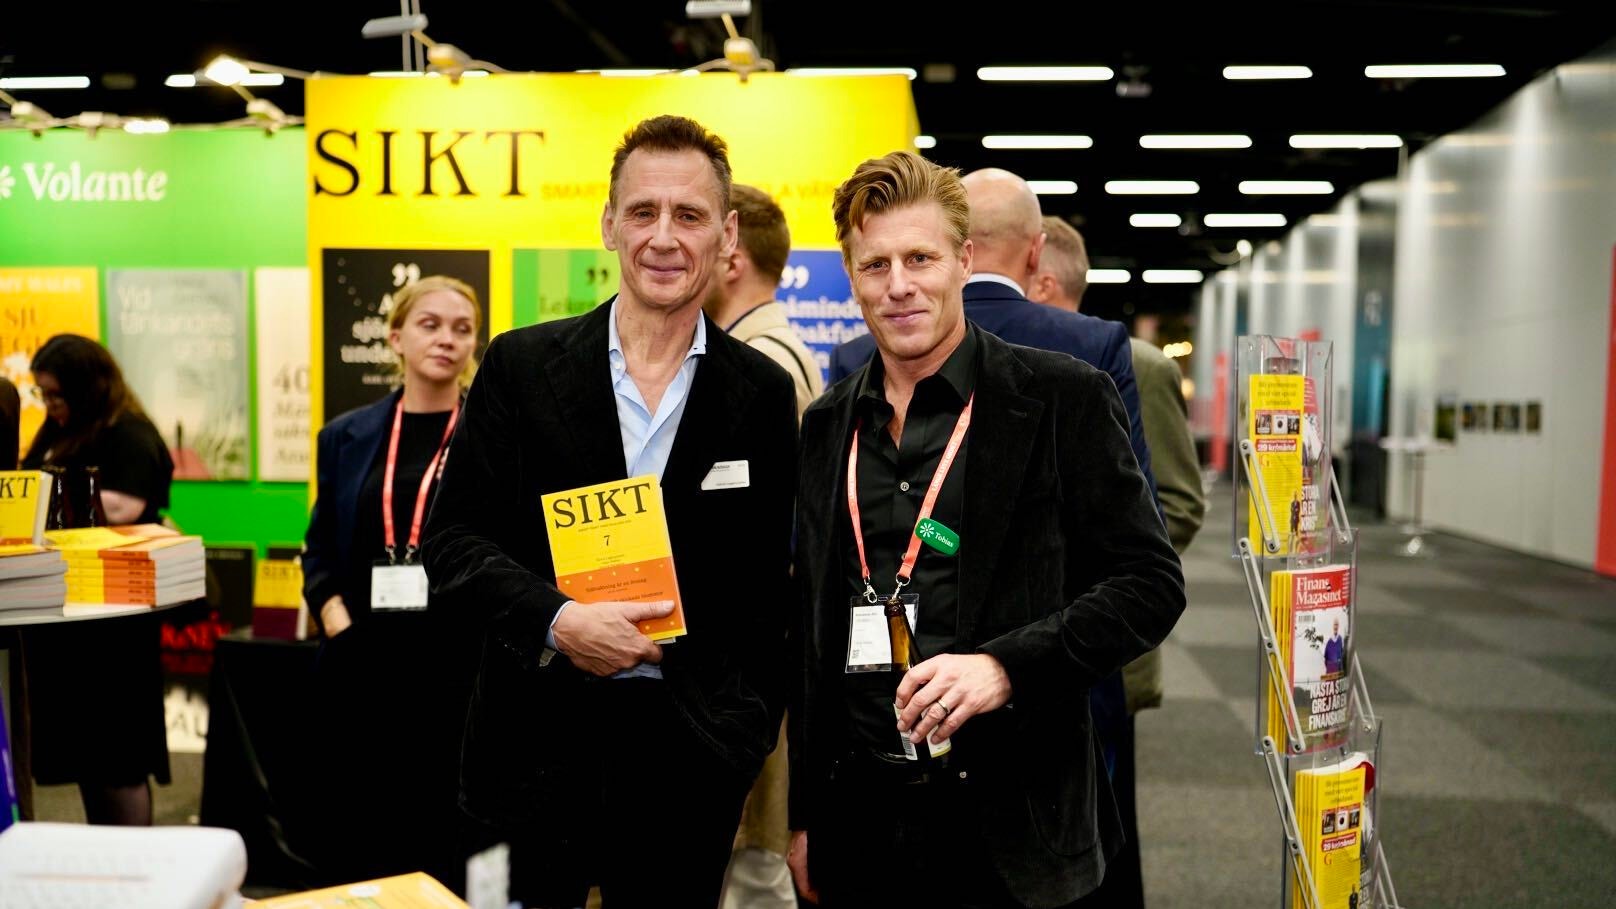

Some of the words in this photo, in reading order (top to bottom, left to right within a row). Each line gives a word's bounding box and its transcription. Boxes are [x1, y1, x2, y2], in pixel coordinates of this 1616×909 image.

[313, 128, 544, 197] SIKT
[22, 161, 168, 201] Volante
[553, 483, 650, 529] SIKT
[604, 535, 611, 546] 7
[934, 531, 954, 548] Tobias
[1296, 576, 1331, 591] Finans
[1296, 589, 1342, 606] Magasinet
[1311, 696, 1331, 716] GREJ
